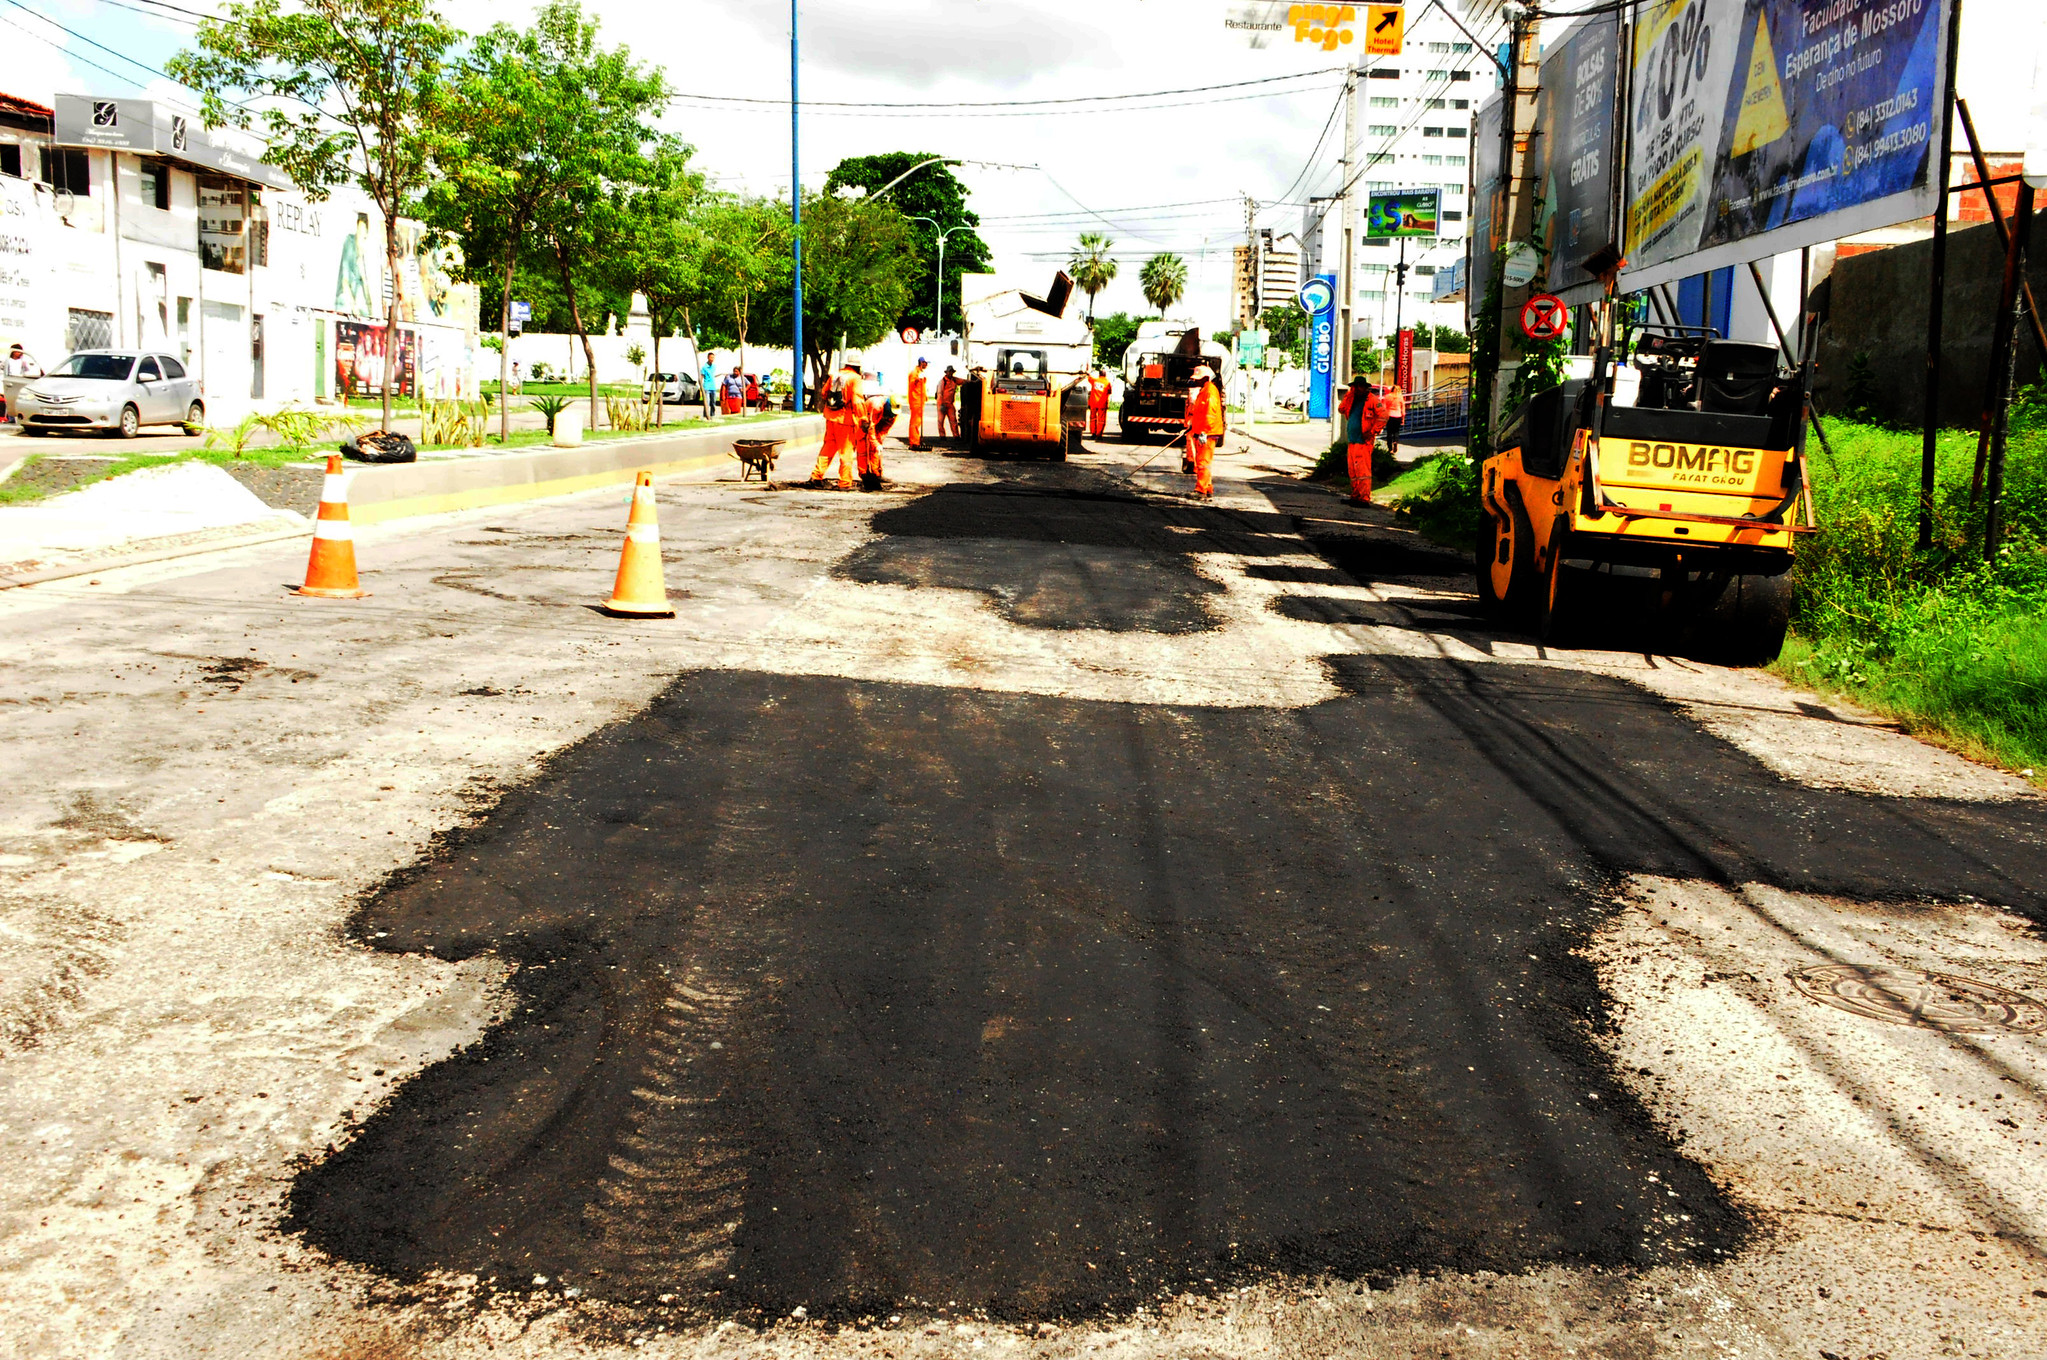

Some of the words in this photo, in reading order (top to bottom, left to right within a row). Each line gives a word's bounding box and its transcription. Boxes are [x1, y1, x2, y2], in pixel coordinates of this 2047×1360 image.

[1225, 19, 1282, 31] Restaurante
[1367, 46, 1399, 54] Thermas
[1576, 47, 1605, 89] BOLSAS
[1785, 33, 1841, 79] Esperança
[1843, 20, 1858, 49] de
[1816, 72, 1827, 92] De
[1828, 63, 1844, 86] olho
[1845, 63, 1855, 79] no
[1857, 49, 1882, 73] futuro
[1856, 106, 1873, 135] (84)
[1875, 88, 1918, 123] 3312.0143
[1855, 141, 1872, 169] (84)
[1874, 121, 1926, 158] 99413.3080
[1570, 149, 1600, 187] GRÁTIS
[277, 201, 320, 237] REPLAY
[1317, 321, 1331, 373] GLOBO
[1401, 337, 1409, 394] Banco24Horas
[1628, 442, 1755, 474] BOMAG
